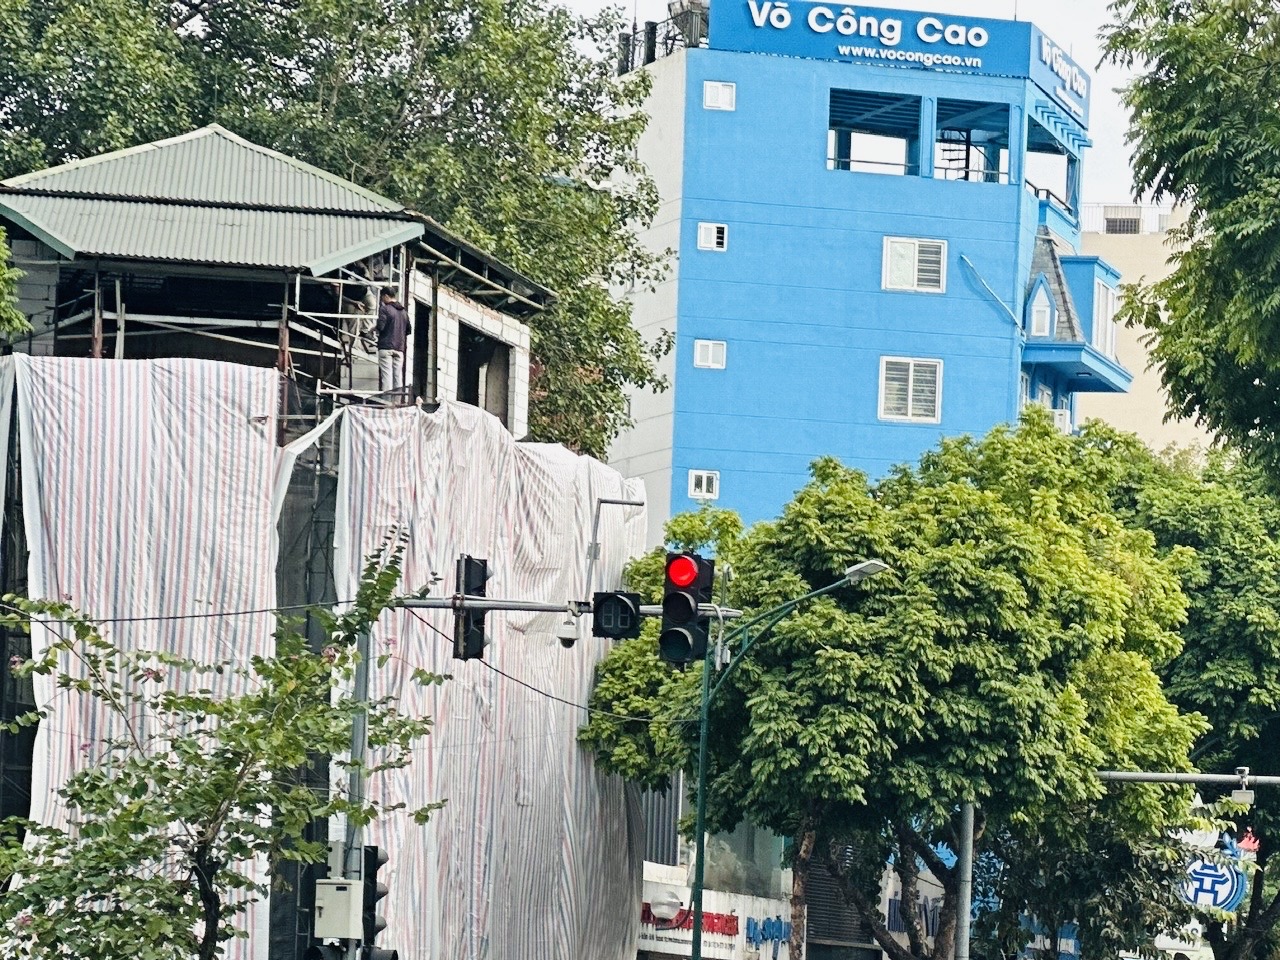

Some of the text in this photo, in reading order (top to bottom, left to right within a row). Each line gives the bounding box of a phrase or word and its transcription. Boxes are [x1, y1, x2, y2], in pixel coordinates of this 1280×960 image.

[748, 0, 989, 48] Võ Công Cao
[838, 44, 982, 68] www.vocongcao.vn
